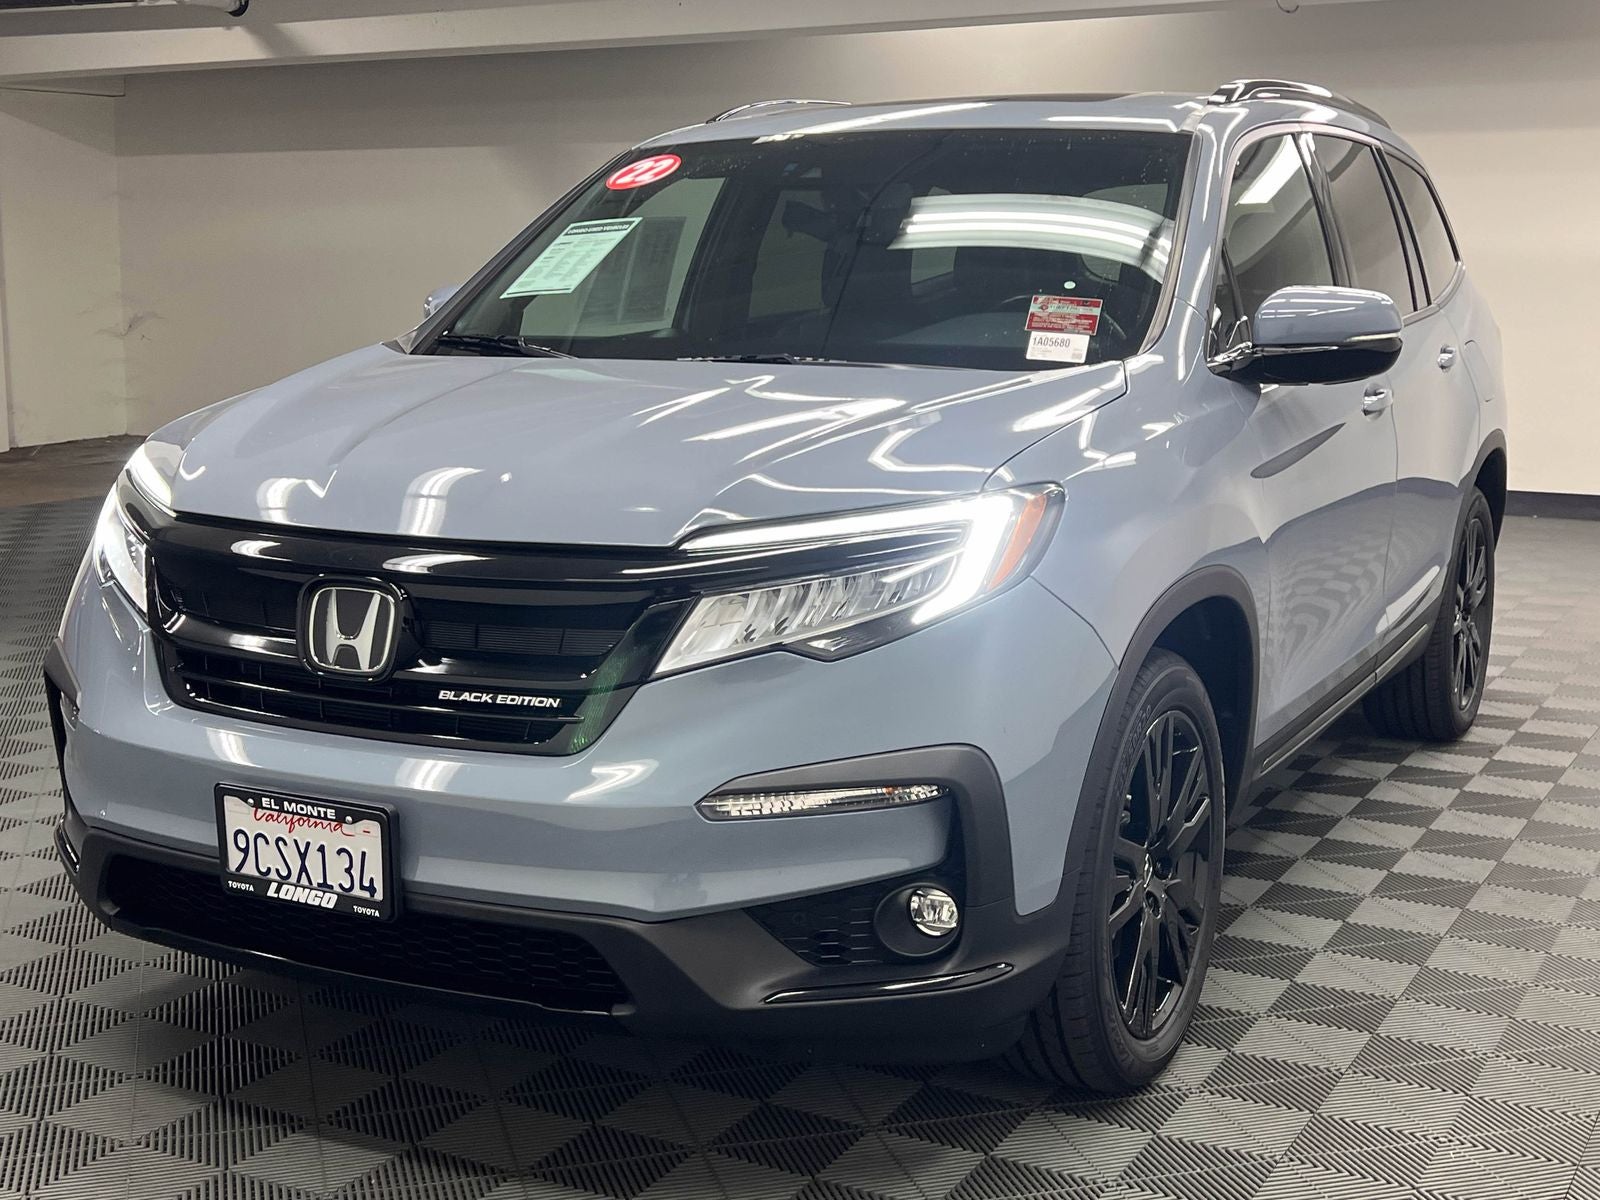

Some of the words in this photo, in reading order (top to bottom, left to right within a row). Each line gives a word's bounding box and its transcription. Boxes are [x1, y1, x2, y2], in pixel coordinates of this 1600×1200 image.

[615, 158, 675, 185] 22
[1032, 336, 1071, 349] 1A05680
[438, 690, 494, 704] BLACK
[495, 694, 561, 708] EDITION
[261, 797, 280, 810] EL
[283, 801, 336, 819] MONTE
[253, 807, 355, 837] California
[233, 828, 377, 898] 9CSX134
[227, 880, 255, 892] TOYOTA
[266, 881, 338, 909] LONGO
[353, 905, 380, 918] TOYOTA
